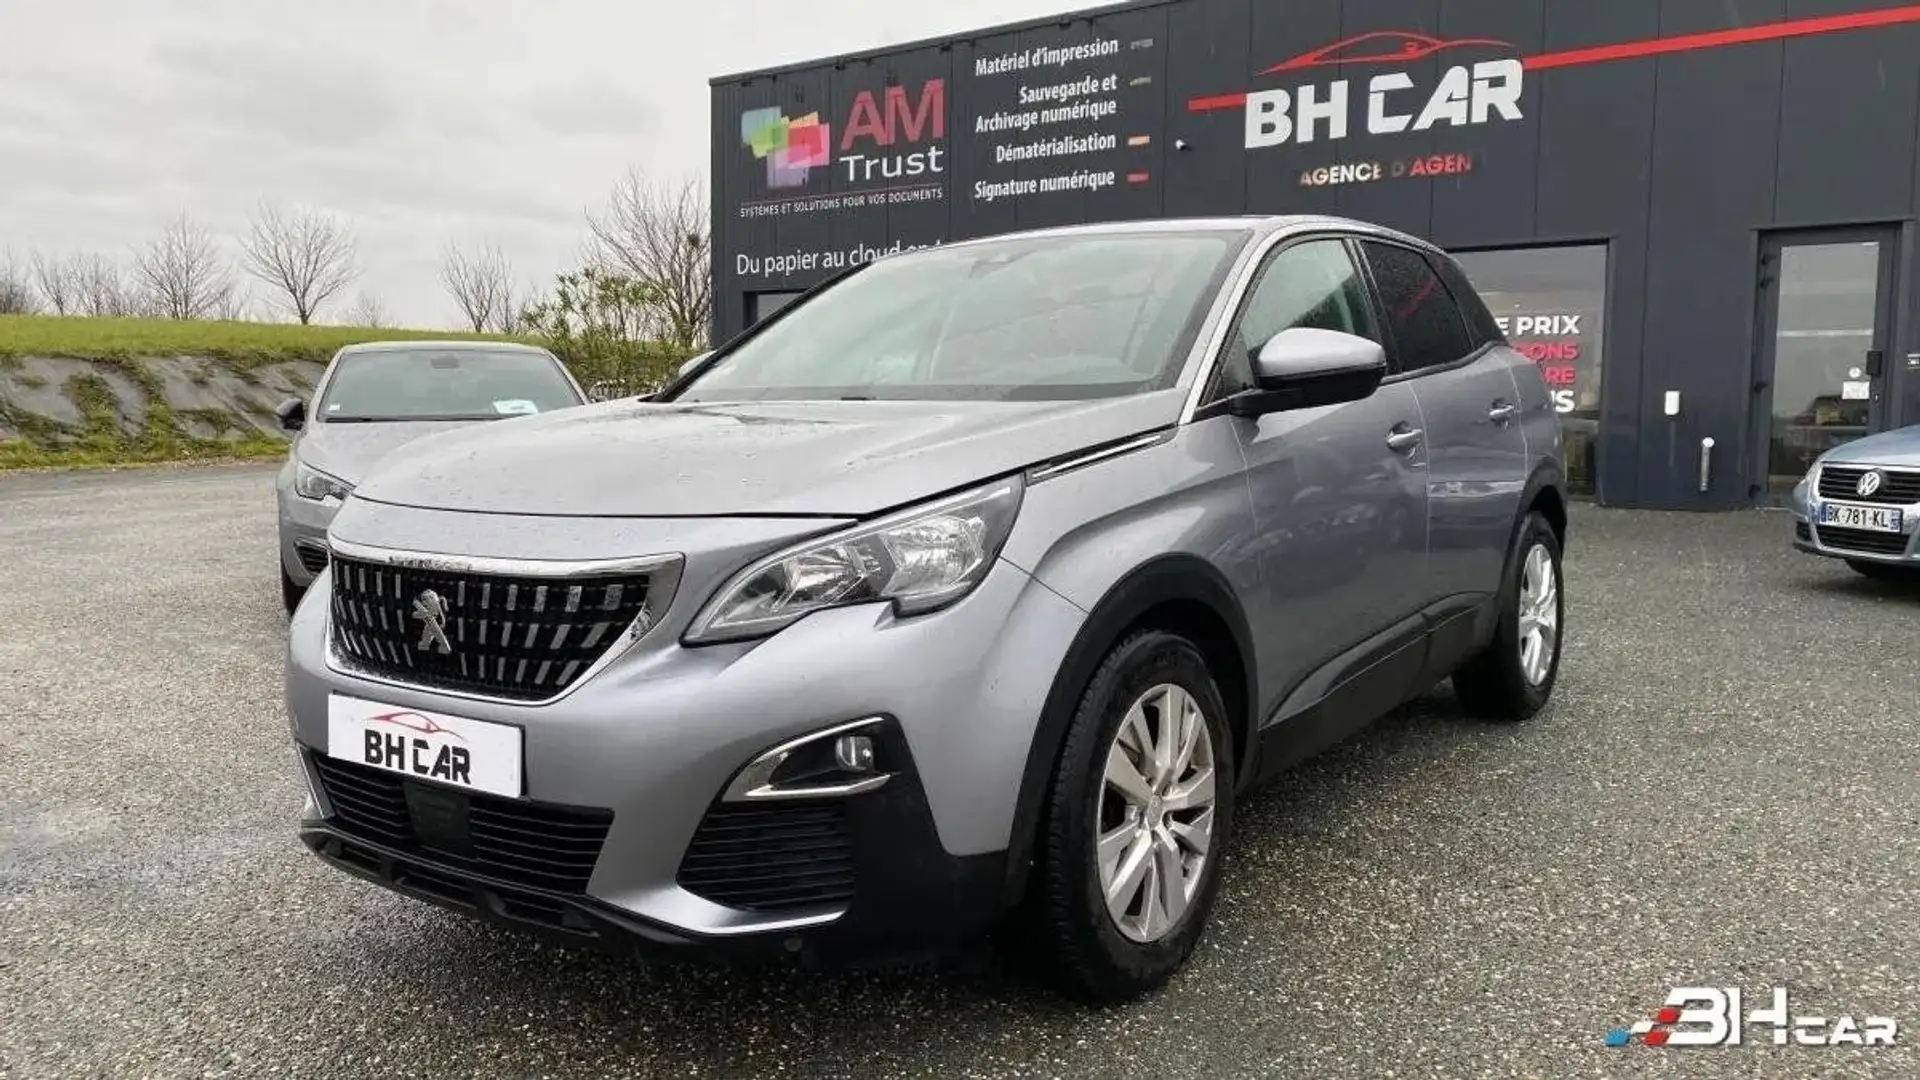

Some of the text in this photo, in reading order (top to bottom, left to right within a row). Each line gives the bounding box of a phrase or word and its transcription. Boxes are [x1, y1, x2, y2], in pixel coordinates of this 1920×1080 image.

[975, 38, 1118, 76] Matériel d'impression
[1019, 73, 1117, 104] Sauvegarde et
[1244, 58, 1524, 149] BH CAR
[840, 78, 944, 151] AM
[975, 99, 1117, 133] Archivage numérique
[839, 145, 944, 181] Trust
[996, 132, 1116, 163] Dématérialisation
[974, 169, 1115, 201] Signature numérique
[1299, 162, 1383, 186] AGENCE
[1410, 153, 1472, 177] AGEN
[782, 202, 792, 214] ET
[794, 198, 840, 213] SOLUTIONS
[843, 195, 866, 208] POUR
[868, 193, 886, 205] VOS
[888, 187, 943, 203] DOCUMENTS
[737, 253, 759, 275] Du
[765, 249, 819, 278] papier
[822, 250, 845, 268] au
[1516, 315, 1580, 336] PRIX
[364, 727, 472, 785] BH CAR
